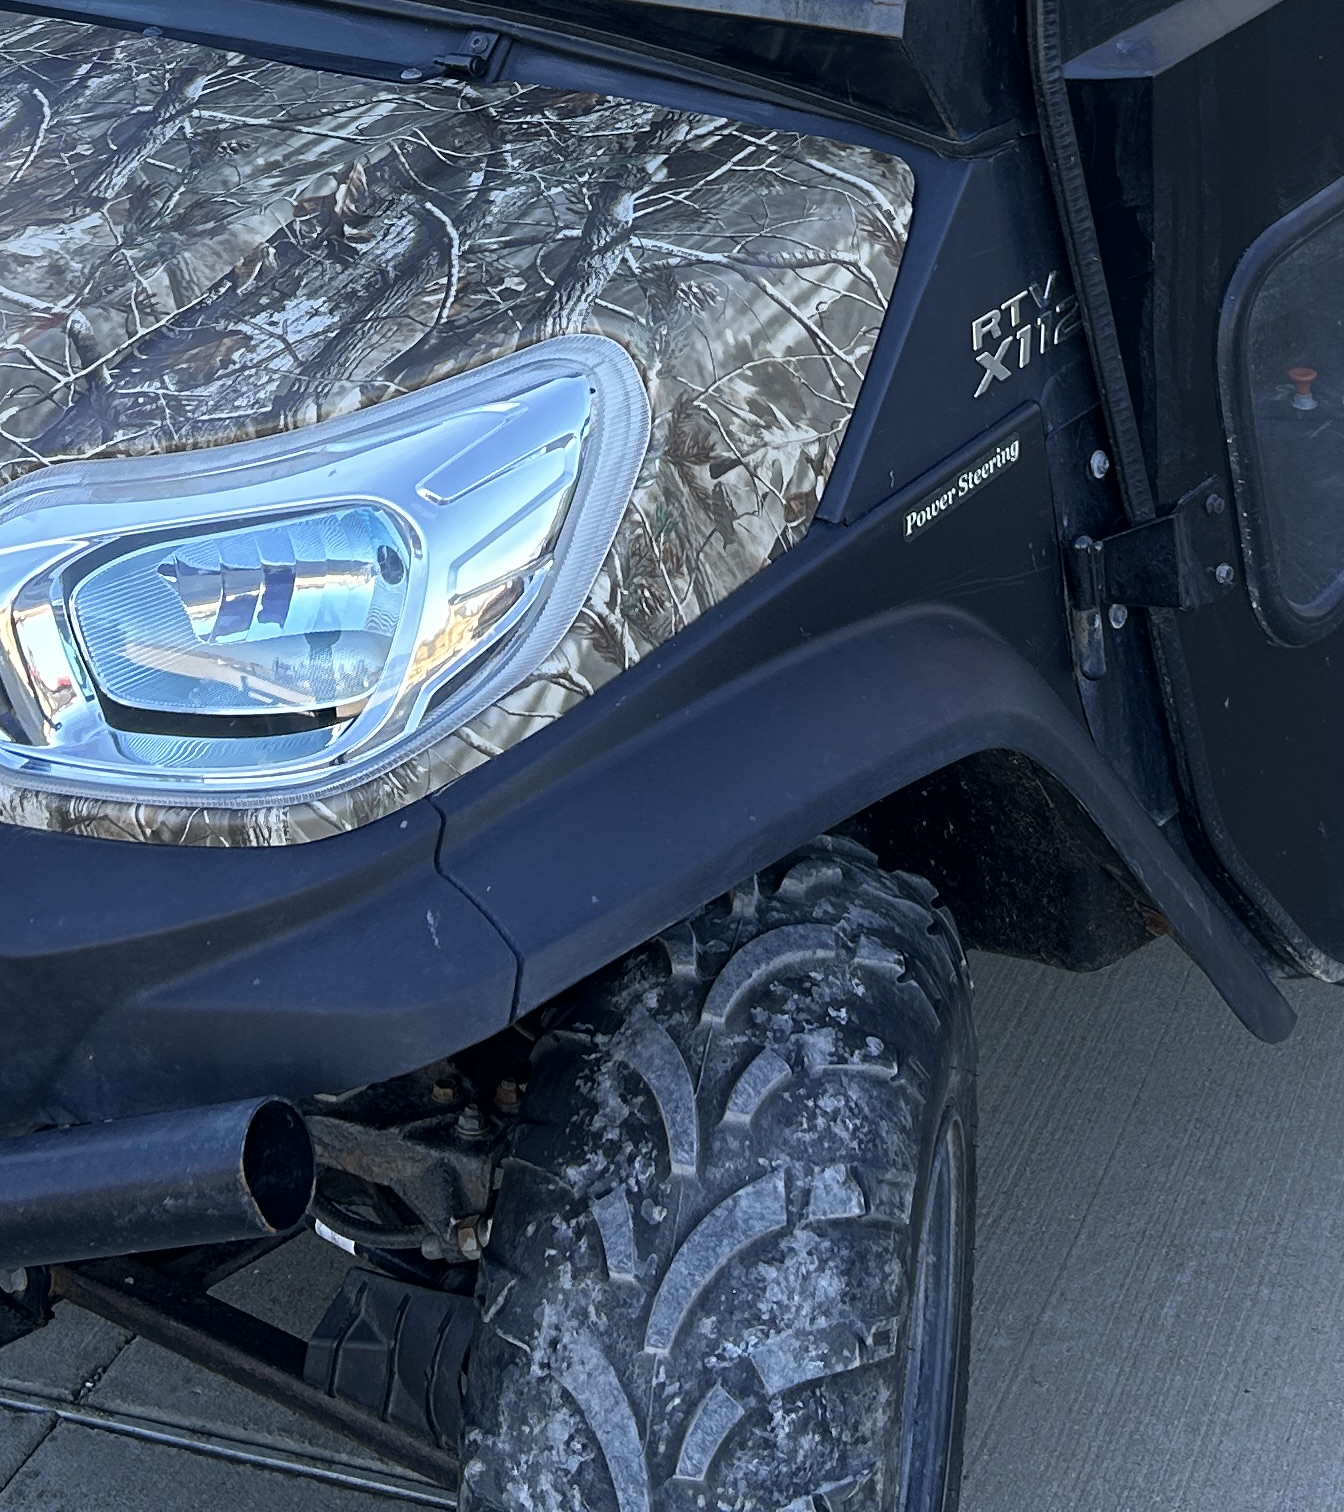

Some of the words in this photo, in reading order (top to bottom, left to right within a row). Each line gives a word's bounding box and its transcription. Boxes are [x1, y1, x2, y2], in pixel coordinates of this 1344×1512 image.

[972, 270, 1056, 351] RTV
[905, 488, 956, 537] Power
[958, 439, 1020, 497] Steering
